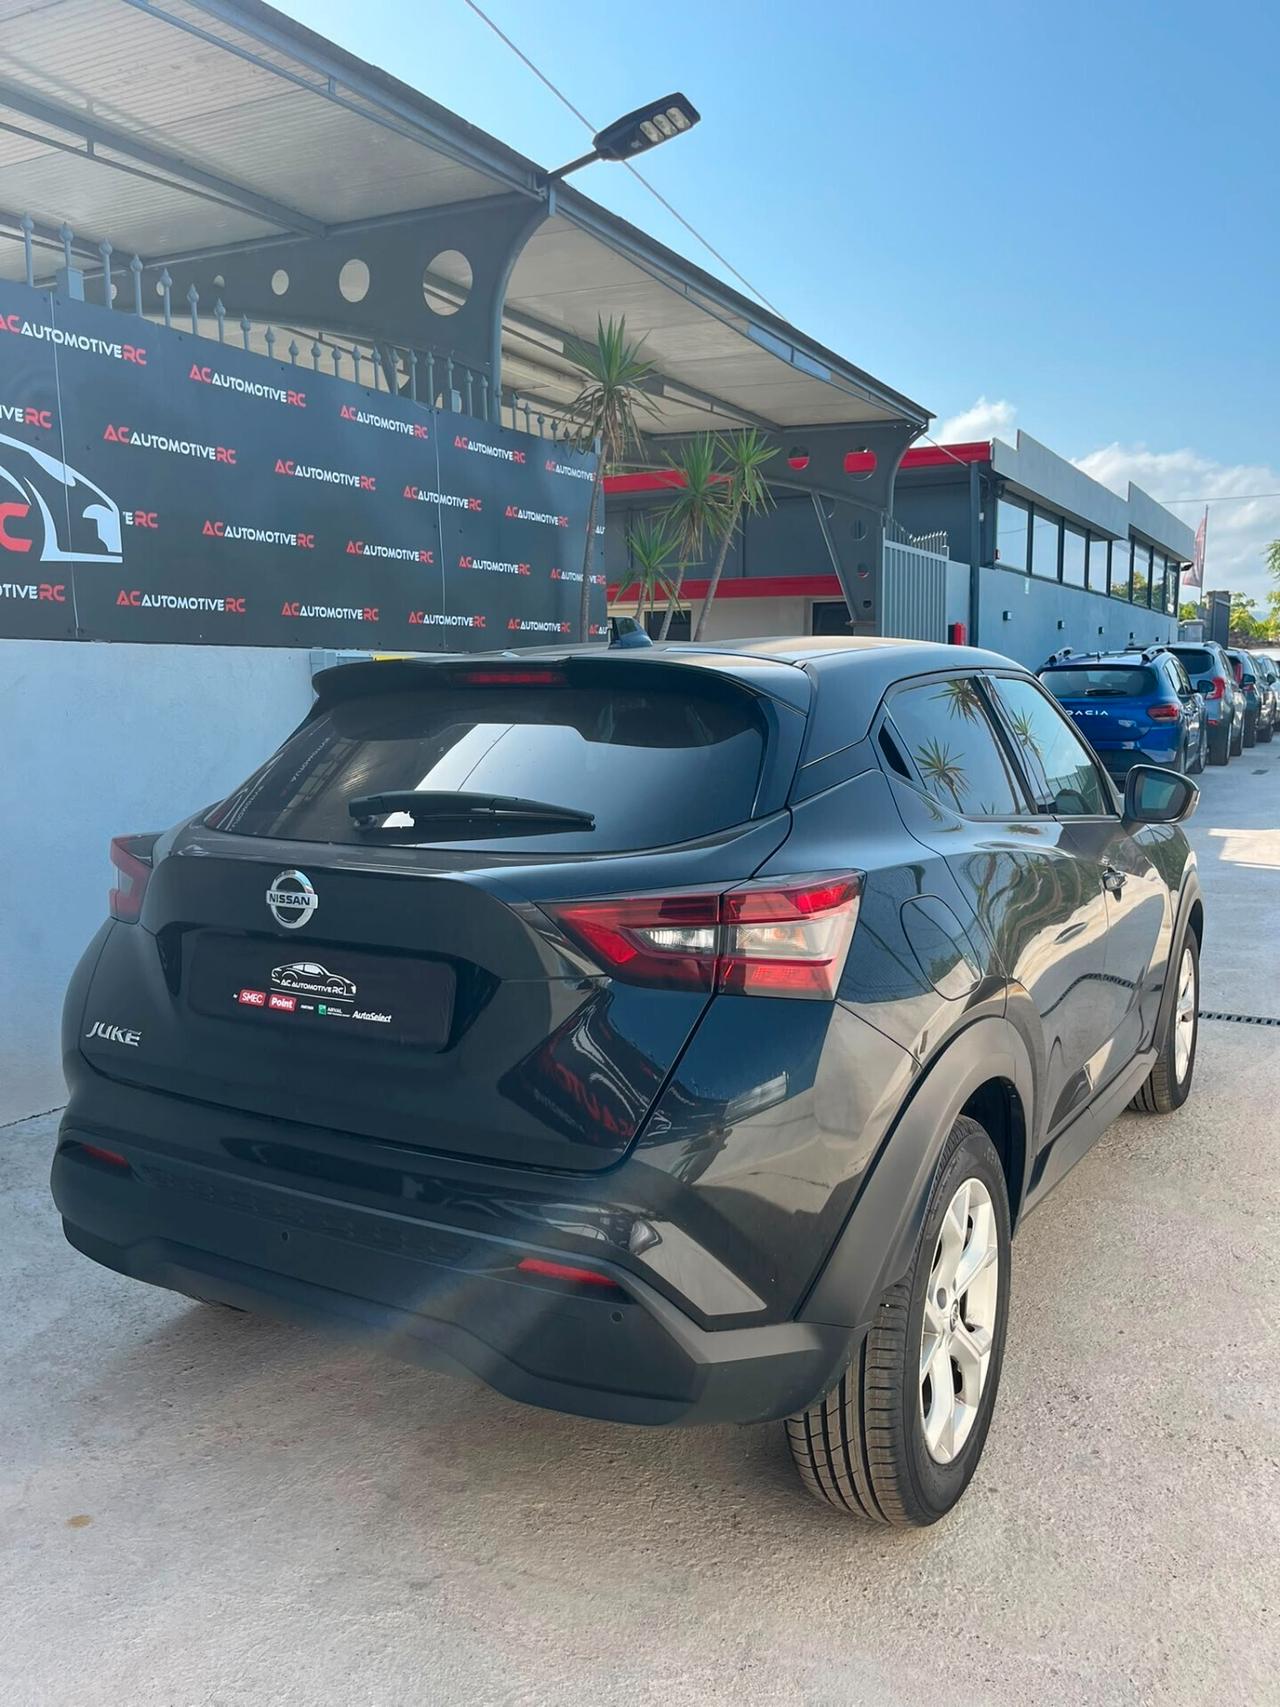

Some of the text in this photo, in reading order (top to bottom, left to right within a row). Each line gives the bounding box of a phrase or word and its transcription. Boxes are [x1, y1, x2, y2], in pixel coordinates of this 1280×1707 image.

[268, 893, 311, 906] NISSAN
[271, 997, 293, 1009] Point
[352, 1010, 392, 1023] AutoSelect
[86, 1021, 142, 1047] JUKE
